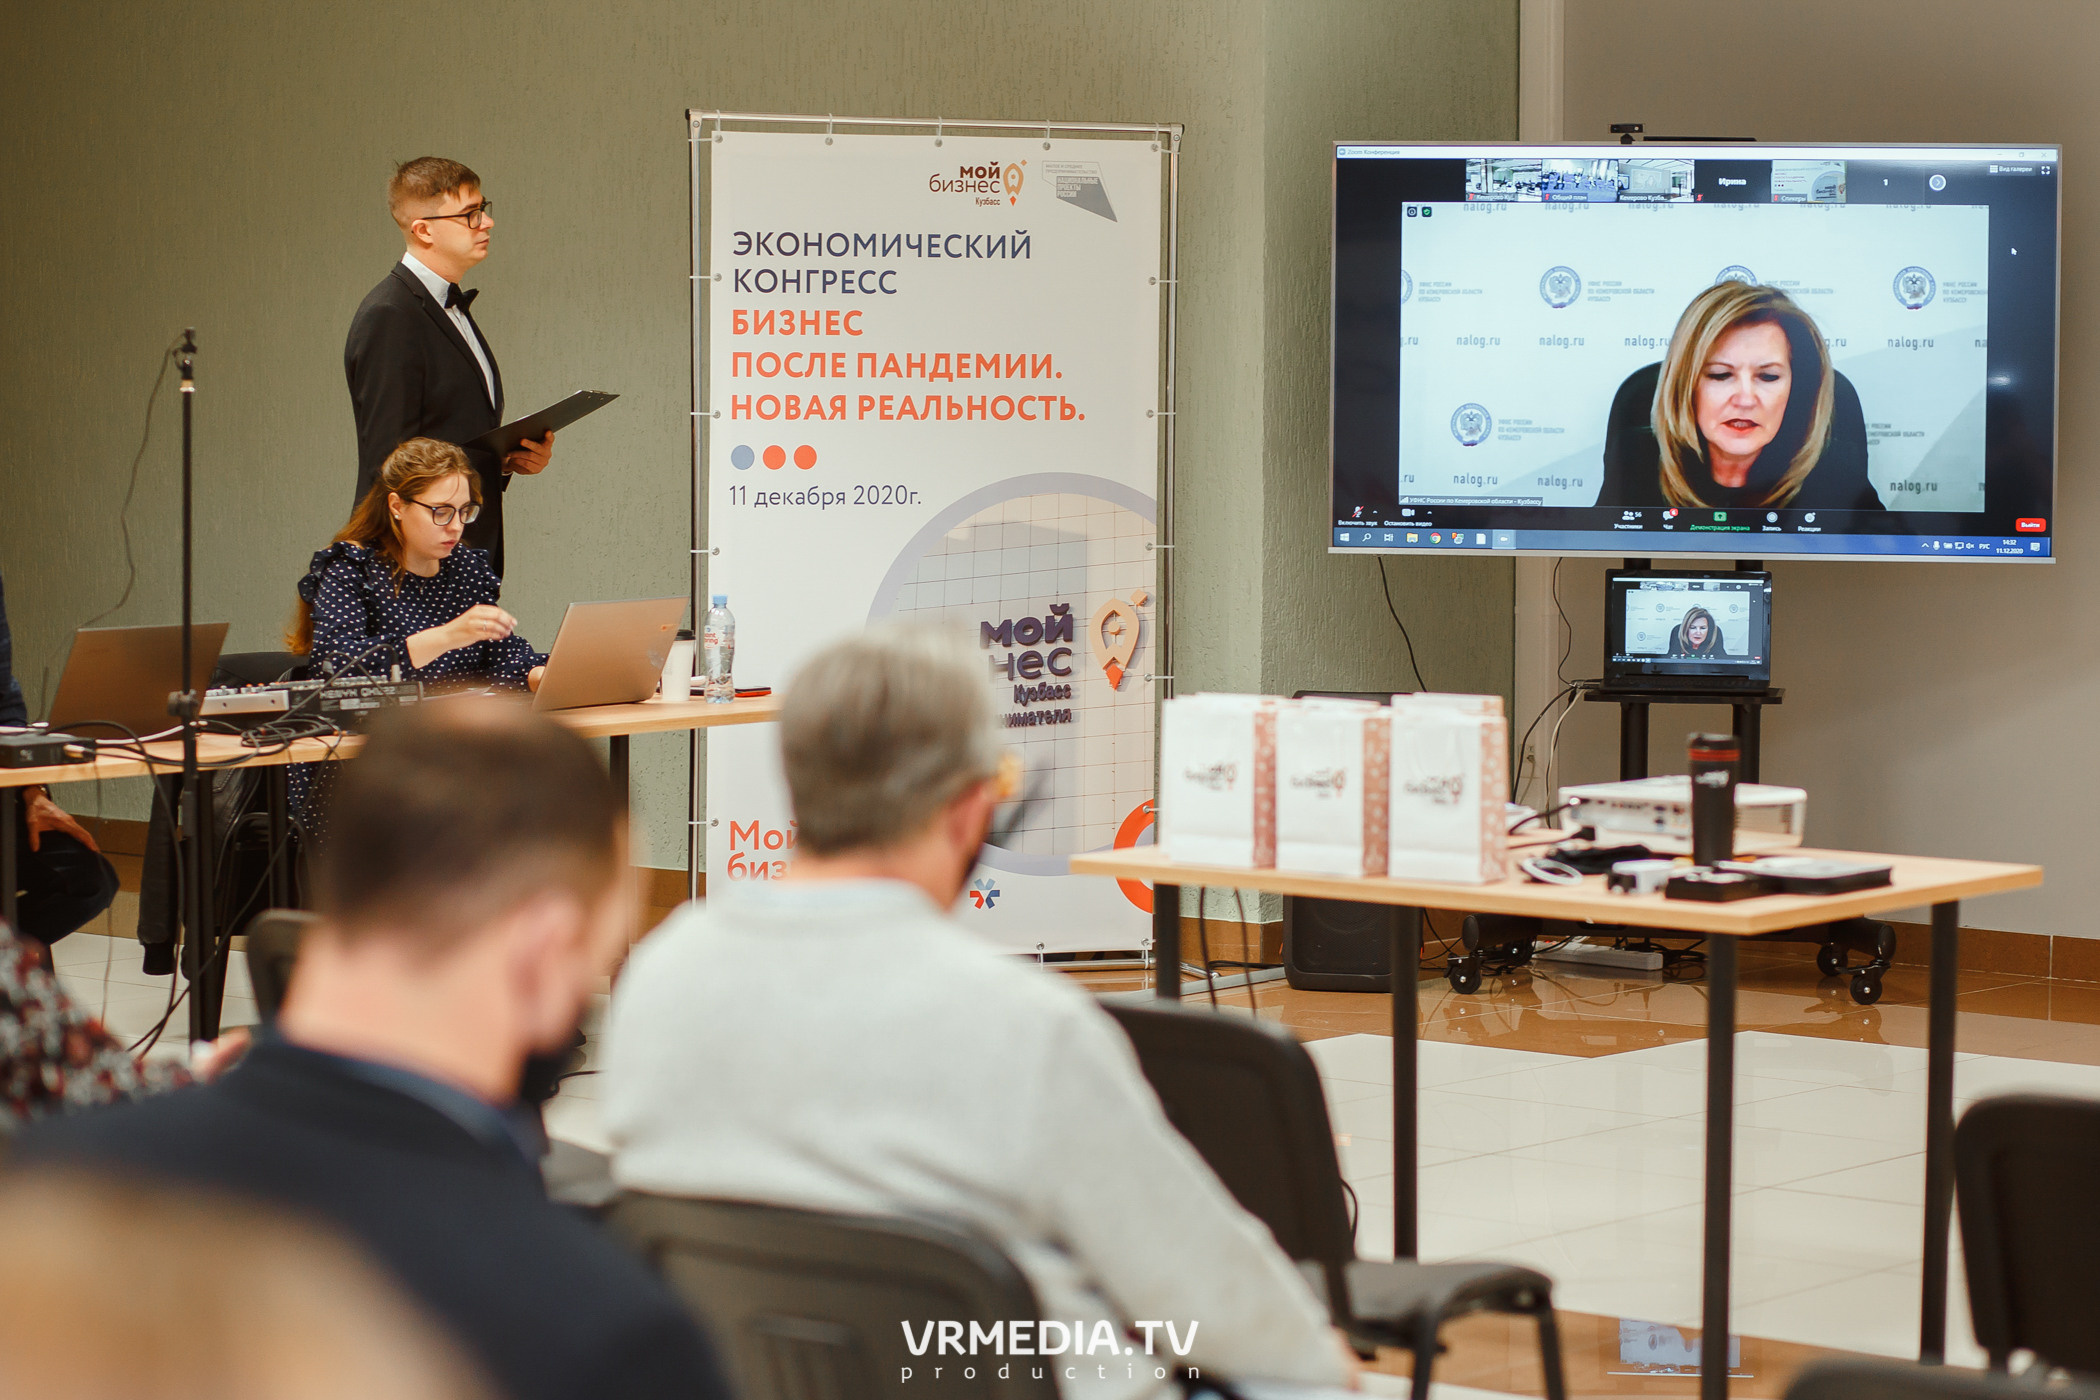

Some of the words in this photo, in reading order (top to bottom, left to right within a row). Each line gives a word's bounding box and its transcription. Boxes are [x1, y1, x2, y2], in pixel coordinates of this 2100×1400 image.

[960, 161, 1000, 179] мой
[929, 173, 1001, 194] бизнес
[1718, 178, 1747, 187] Ирина
[1883, 178, 1889, 186] 1
[975, 197, 1001, 207] Кузбасс
[732, 229, 1031, 260] ЭКОНОМИЧЕСКИЙ
[733, 268, 898, 295] КОНГРЕСС
[731, 309, 864, 336] БИЗНЕС
[1456, 334, 1500, 349] nalog.ru
[1539, 334, 1585, 349] nalog.ru
[1887, 335, 1934, 351] nalog.ru
[731, 351, 847, 379] ПОСЛЕ
[857, 353, 1063, 382] ПАНДЕМИИ.
[731, 394, 847, 421] НОВАЯ
[858, 395, 1086, 421] РЕАЛЬНОСТЬ.
[1453, 472, 1498, 487] nalog.ru
[1537, 474, 1583, 490] nalog.ru
[1889, 480, 1938, 494] nalog.ru
[729, 485, 746, 505] 11
[754, 485, 846, 510] декабря
[853, 485, 922, 505] 2020г.
[979, 603, 1074, 649] мой
[988, 646, 1073, 682] нес
[1013, 681, 1072, 706] Кузбасс
[1001, 708, 1073, 728] нимателя
[727, 851, 789, 881] биз
